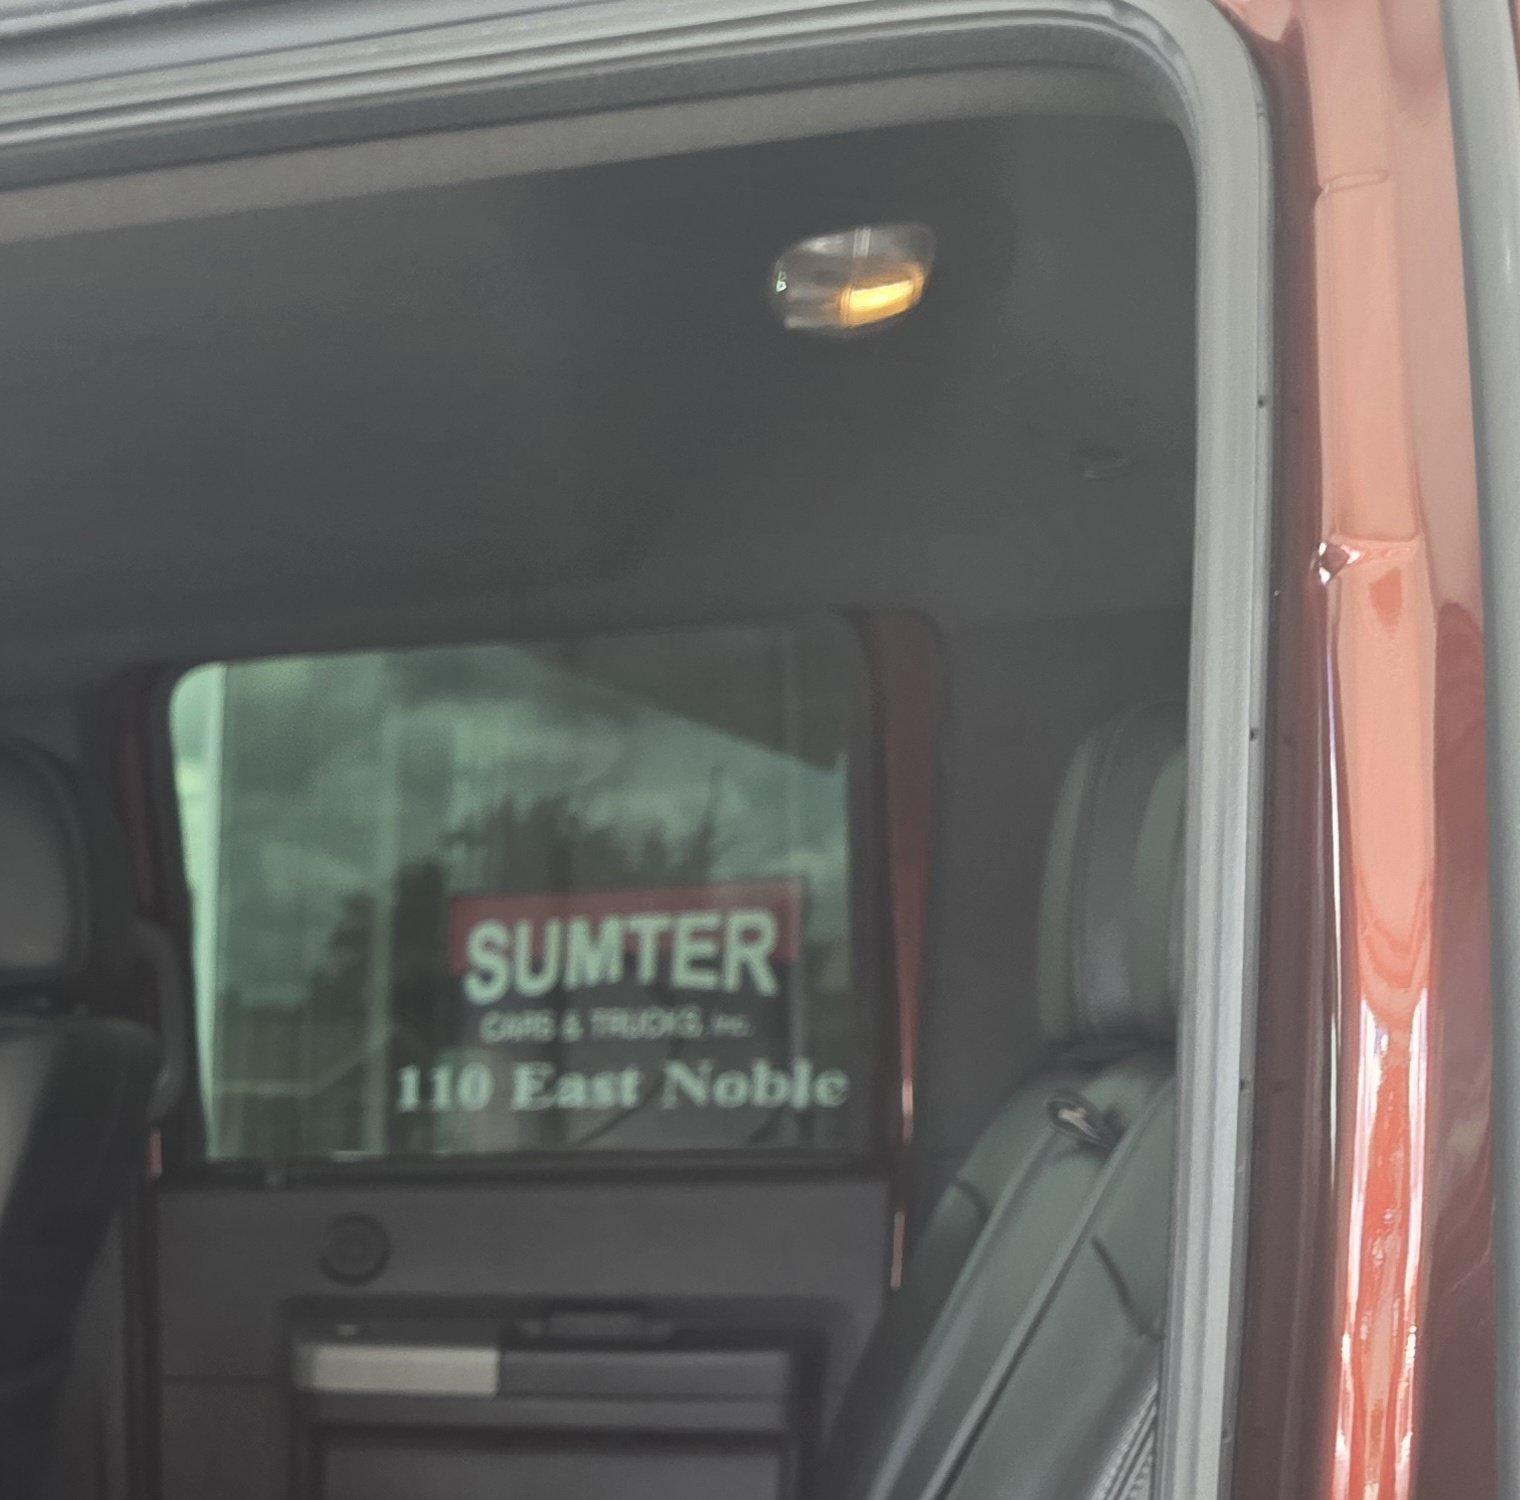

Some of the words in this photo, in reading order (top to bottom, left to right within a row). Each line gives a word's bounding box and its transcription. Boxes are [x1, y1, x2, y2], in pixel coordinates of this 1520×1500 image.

[465, 908, 779, 1004] SUMTER
[398, 1063, 494, 1112] 110
[511, 1061, 642, 1111] East
[664, 1057, 850, 1109] Noble
